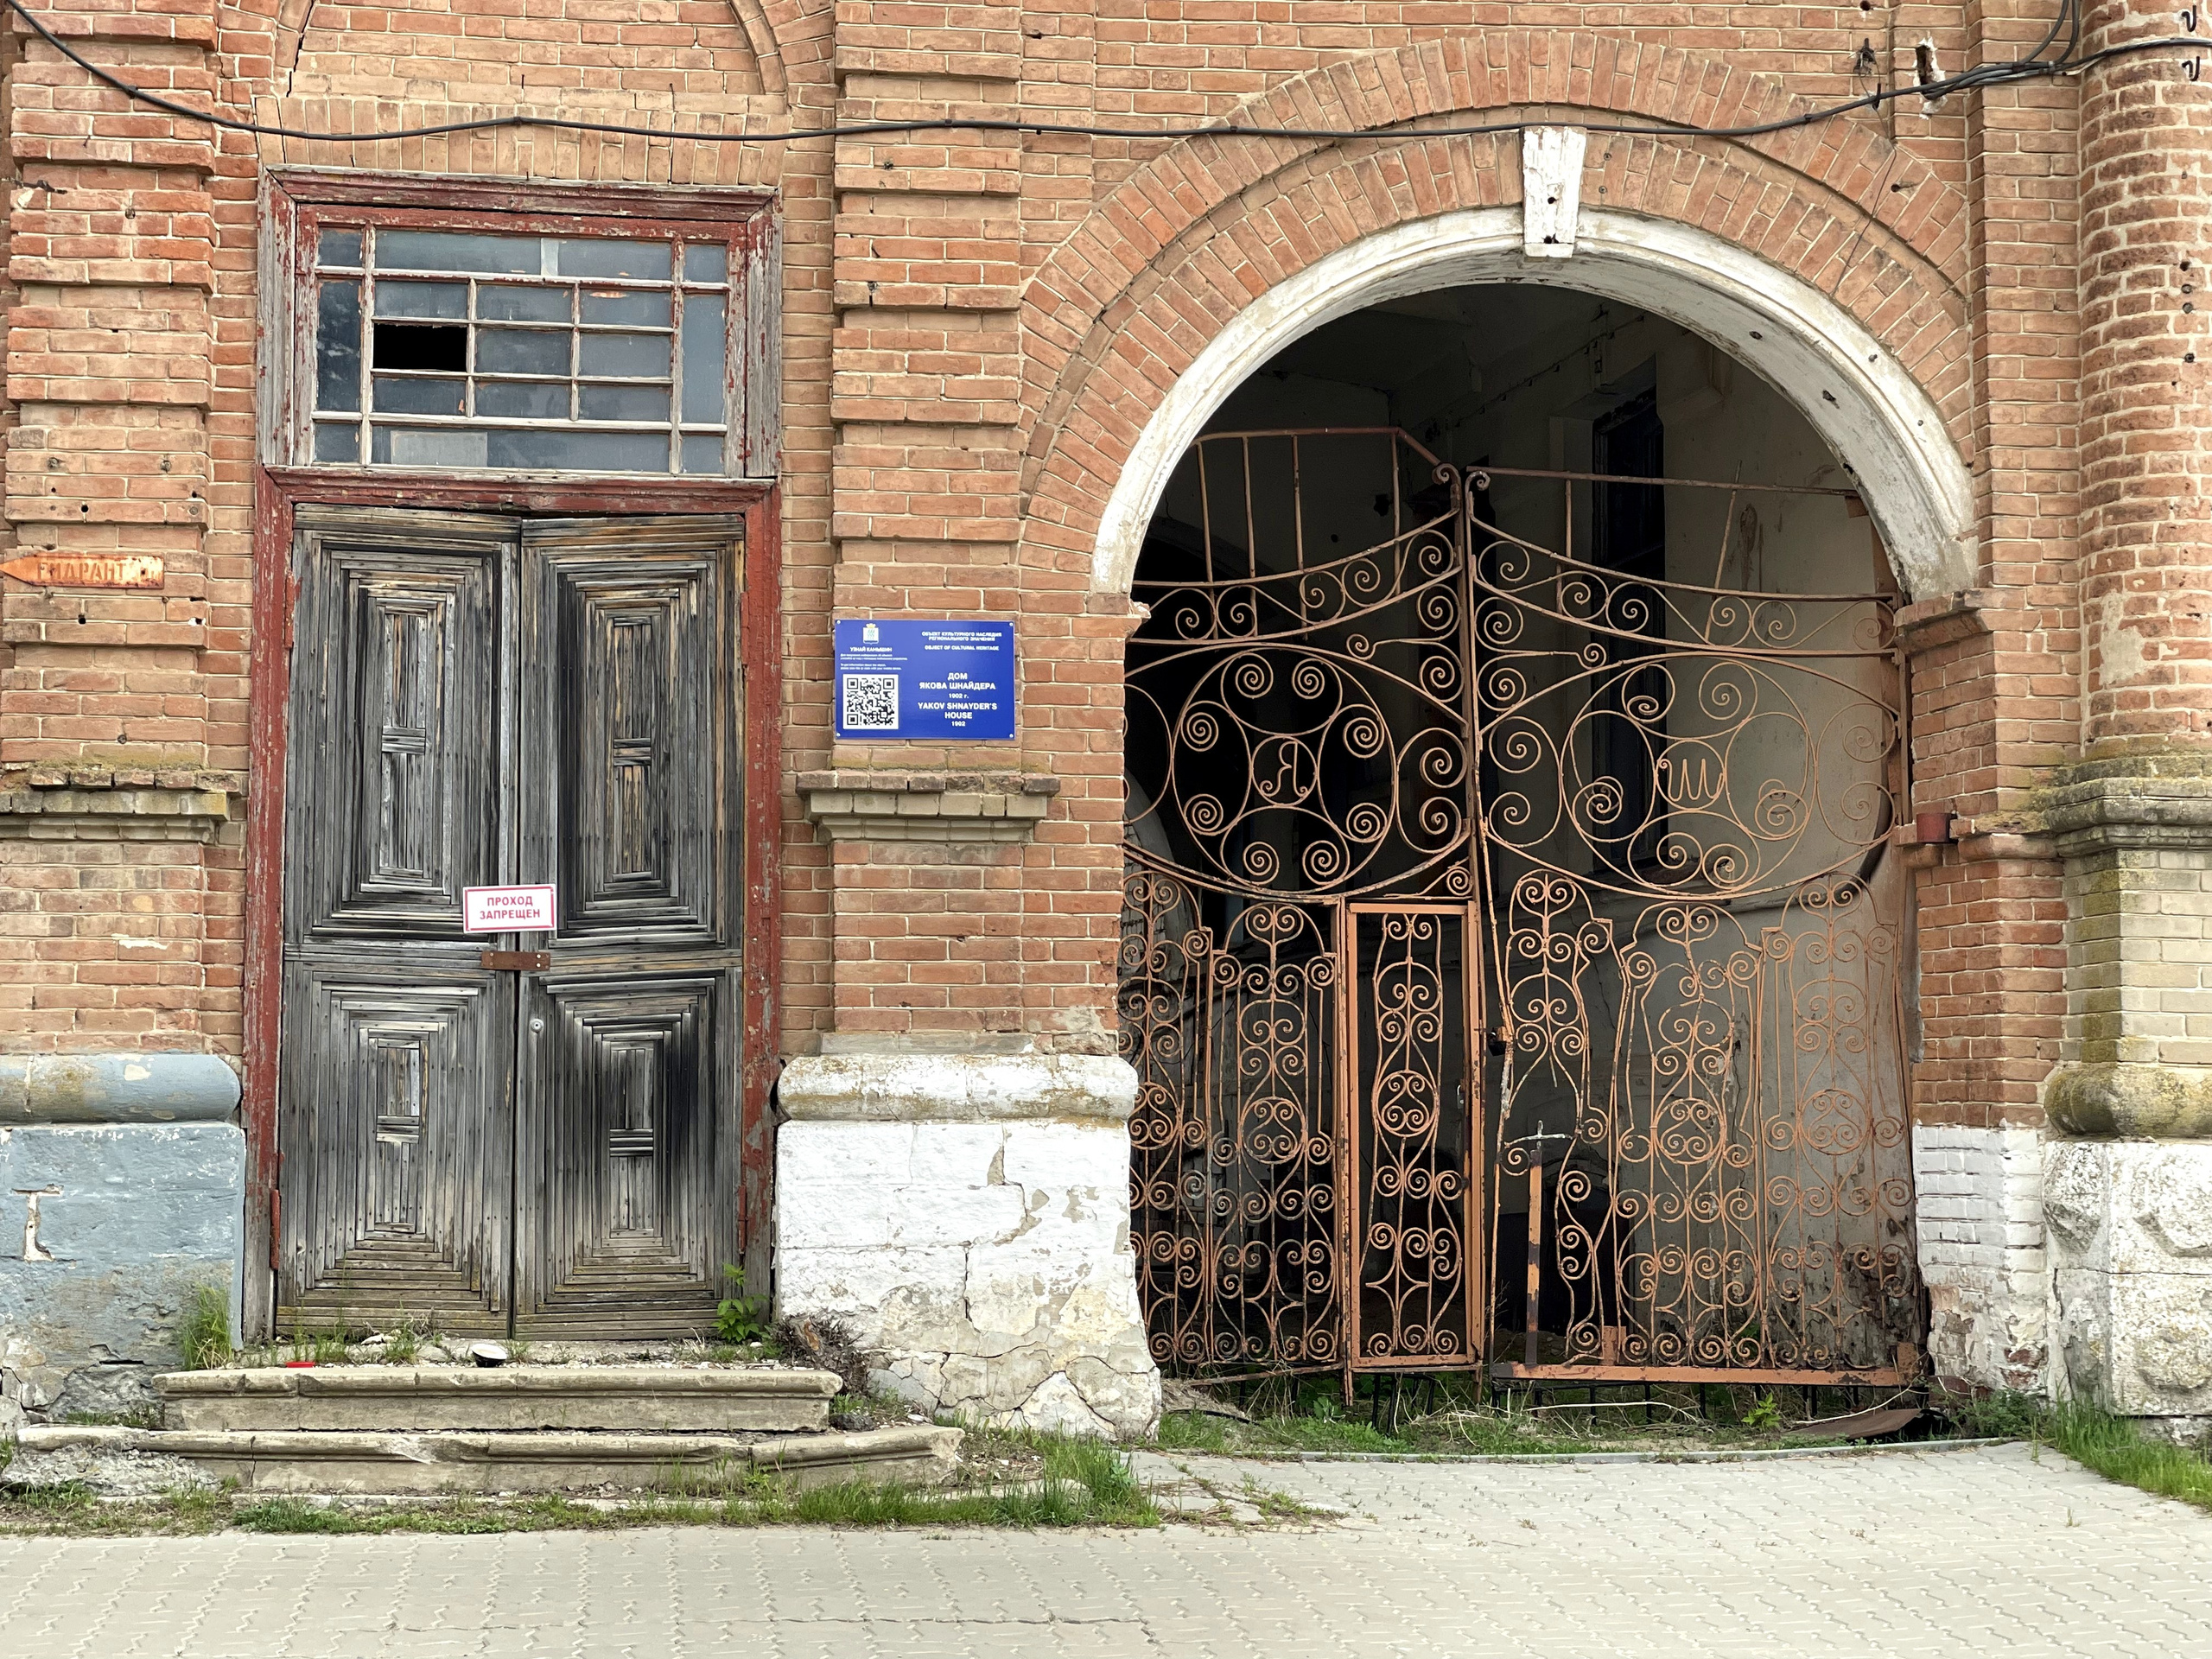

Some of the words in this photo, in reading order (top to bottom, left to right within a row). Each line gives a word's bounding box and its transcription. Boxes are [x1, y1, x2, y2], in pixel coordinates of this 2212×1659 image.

[37, 563, 126, 582] ГИДРАНТ
[947, 672, 968, 681] ДОМ
[949, 681, 996, 691] ШНАЙДЕРА
[487, 896, 533, 906] ПРОХОД
[480, 909, 541, 920] ЗАПРЕЩЕН
